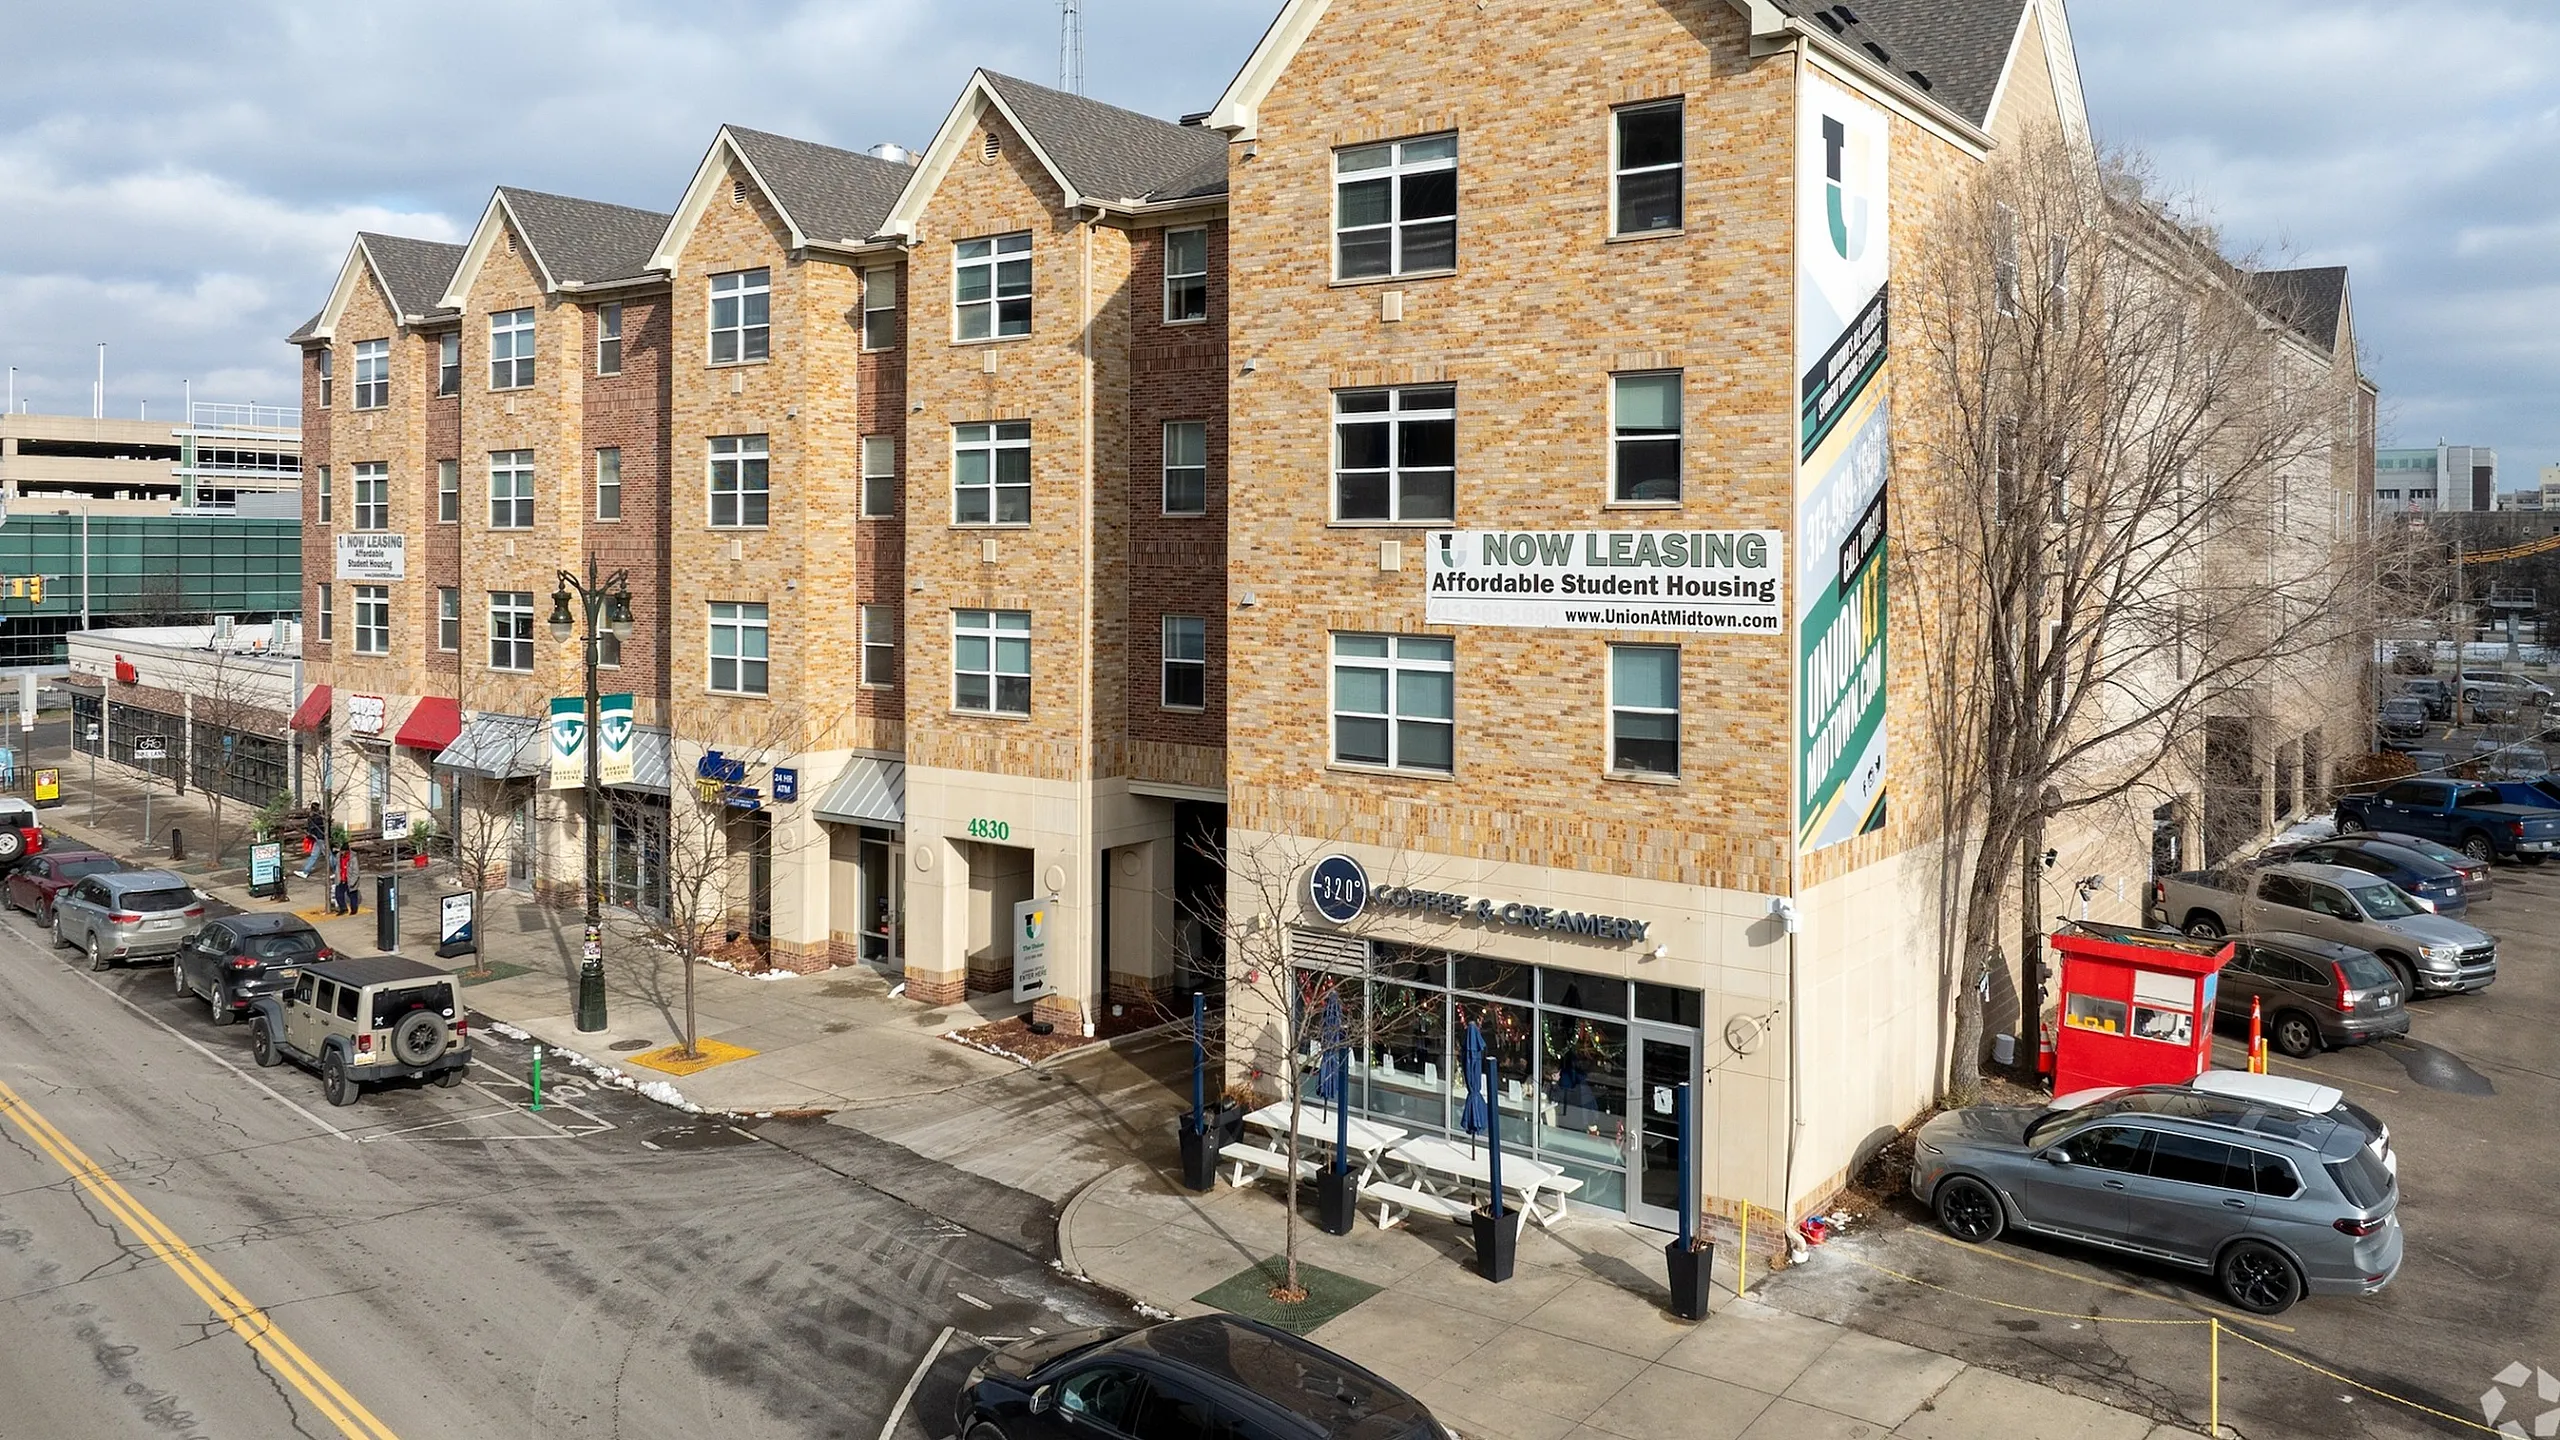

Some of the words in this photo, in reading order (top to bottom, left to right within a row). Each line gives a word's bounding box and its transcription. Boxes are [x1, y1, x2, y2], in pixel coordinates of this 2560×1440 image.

[347, 536, 366, 548] NOW
[367, 536, 402, 548] LEASING
[1482, 533, 1575, 567] NOW
[1586, 533, 1768, 569] LEASING
[355, 549, 384, 557] Affordable
[1843, 535, 1860, 584] CALL
[348, 559, 369, 568] Student
[370, 560, 393, 570] Housing
[1432, 572, 1554, 594] Affordable
[1561, 573, 1659, 596] Student
[1667, 575, 1776, 602] Housing
[1565, 608, 1778, 629] www.UnionAtMidtown.com
[1806, 638, 1881, 805] MIDTOWN.COM
[775, 774, 783, 782] 24
[784, 774, 793, 784] HR
[776, 784, 791, 793] ATM
[967, 818, 1010, 841] 4830
[1374, 884, 1470, 917] COFFEE
[1475, 898, 1495, 920] &
[1502, 902, 1652, 943] CREAMERY
[1019, 973, 1034, 982] ENTER
[1034, 969, 1047, 978] HERE
